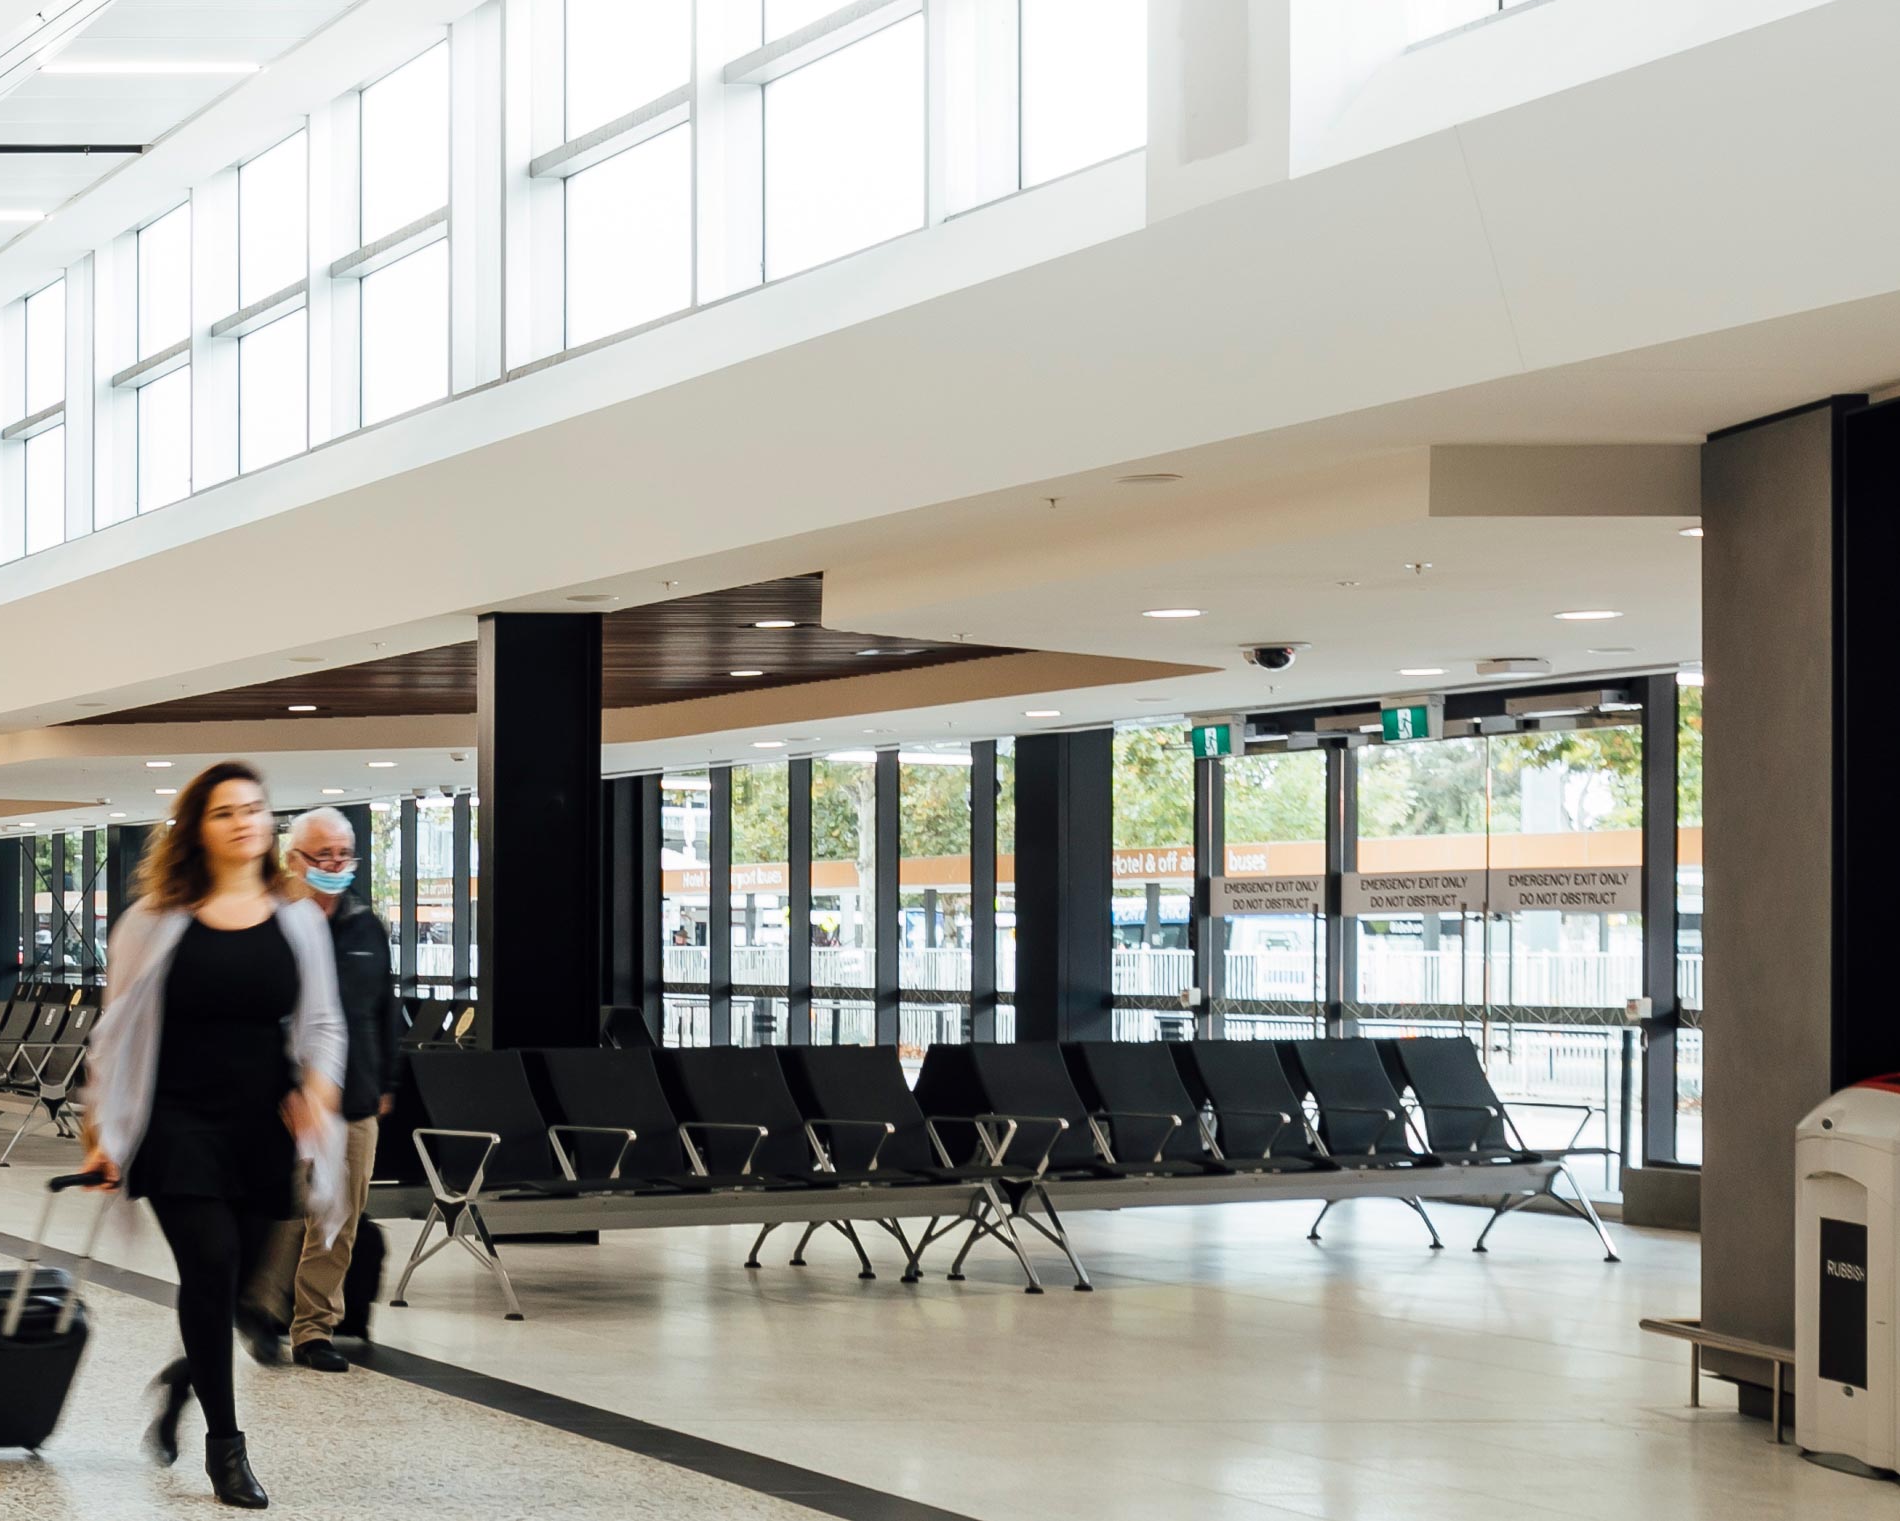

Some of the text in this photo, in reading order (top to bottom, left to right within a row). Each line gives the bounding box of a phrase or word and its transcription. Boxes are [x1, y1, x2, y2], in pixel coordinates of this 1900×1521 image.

[1146, 853, 1155, 873] &
[1159, 851, 1177, 872] off
[1229, 851, 1267, 872] buses
[1360, 876, 1468, 890] EMERGENCY EXIT ONLY
[1509, 872, 1629, 886] EMERGENCY EXIT ONLY
[1224, 881, 1319, 894] EMERGENCY EXIT ONLY
[1233, 898, 1309, 910] DO NOT OBSTRUCT
[1371, 895, 1457, 907] DO NOT OBSTRUCT
[1520, 892, 1616, 905] DO NOT OBSTRUCT
[1827, 1259, 1865, 1282] RUBBISH
